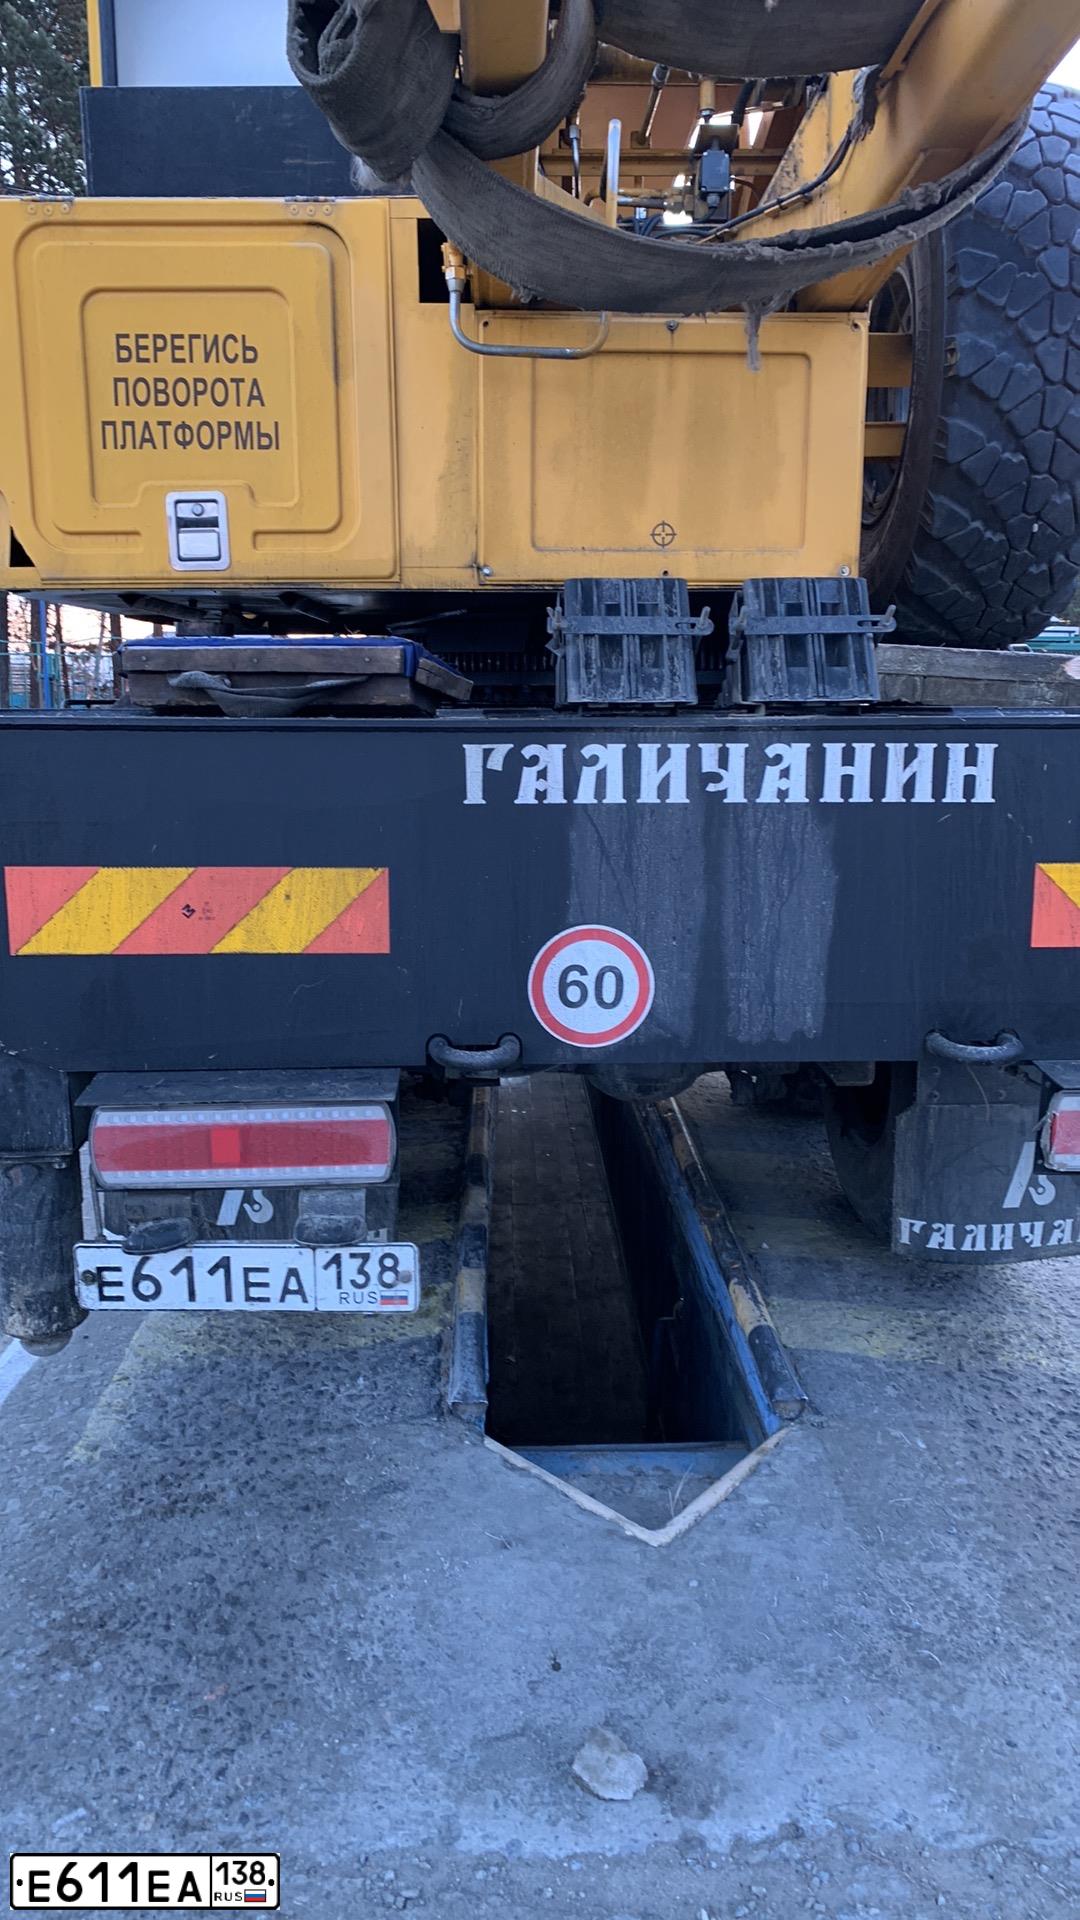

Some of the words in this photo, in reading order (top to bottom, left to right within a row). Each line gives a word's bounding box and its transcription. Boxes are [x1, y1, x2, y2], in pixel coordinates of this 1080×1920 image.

[114, 333, 259, 364] БЕРЕГИСЬ
[112, 376, 266, 407] ПОВОРОТА
[101, 420, 280, 450] ПЛАТФОРМЫ
[462, 741, 1000, 805] ГАЛИЧАНИН
[557, 963, 625, 1009] 60
[898, 1217, 1080, 1252] ГАЛИЧА
[322, 1251, 400, 1290] 138
[338, 1290, 378, 1305] RUS
